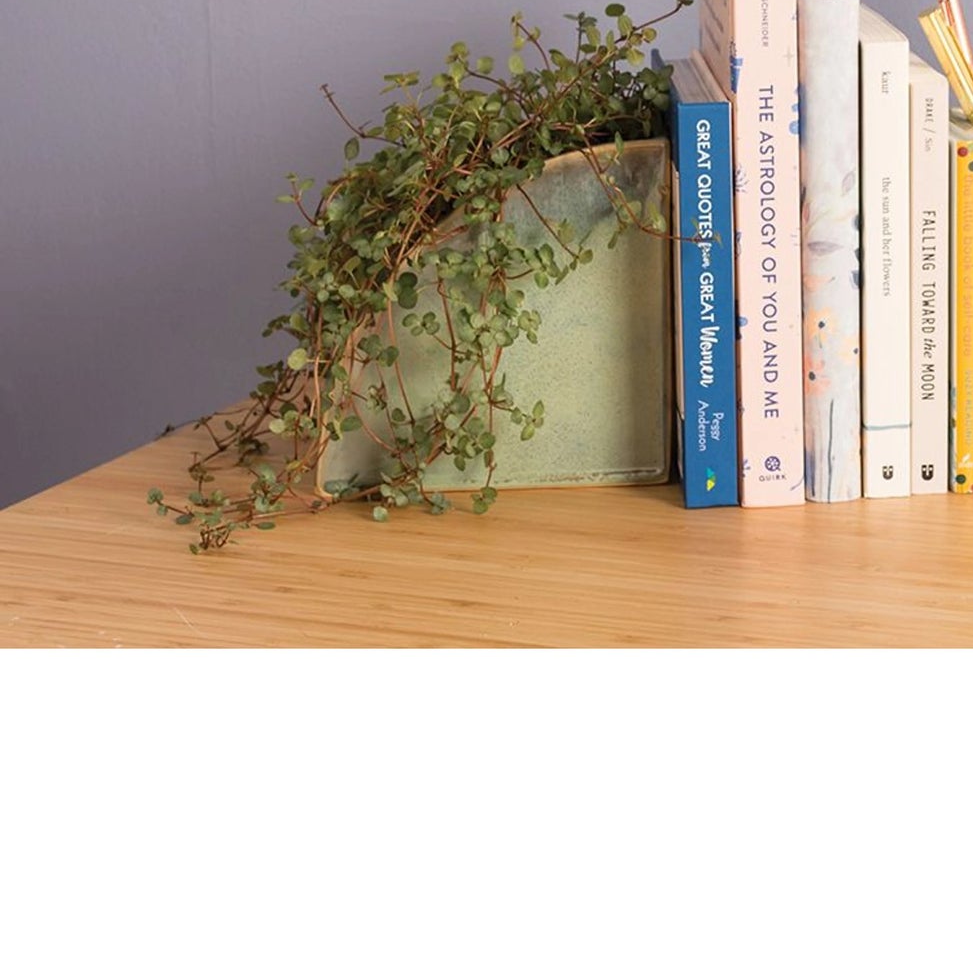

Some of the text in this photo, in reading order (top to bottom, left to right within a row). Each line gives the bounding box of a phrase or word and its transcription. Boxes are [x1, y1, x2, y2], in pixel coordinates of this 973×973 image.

[881, 70, 892, 94] kaur
[696, 119, 712, 170] GREAT
[697, 174, 713, 239] QUOTES
[757, 85, 779, 419] THE ASTROLOGY OF YOU AND ME
[881, 176, 893, 297] the sun and her flowers
[699, 272, 715, 322] GREAT
[920, 210, 937, 401] FALLING TOWARD the MOON
[699, 326, 720, 388] Women
[697, 399, 710, 453] Anderson
[710, 411, 725, 441] Peggy
[758, 474, 787, 482] QUIRK
